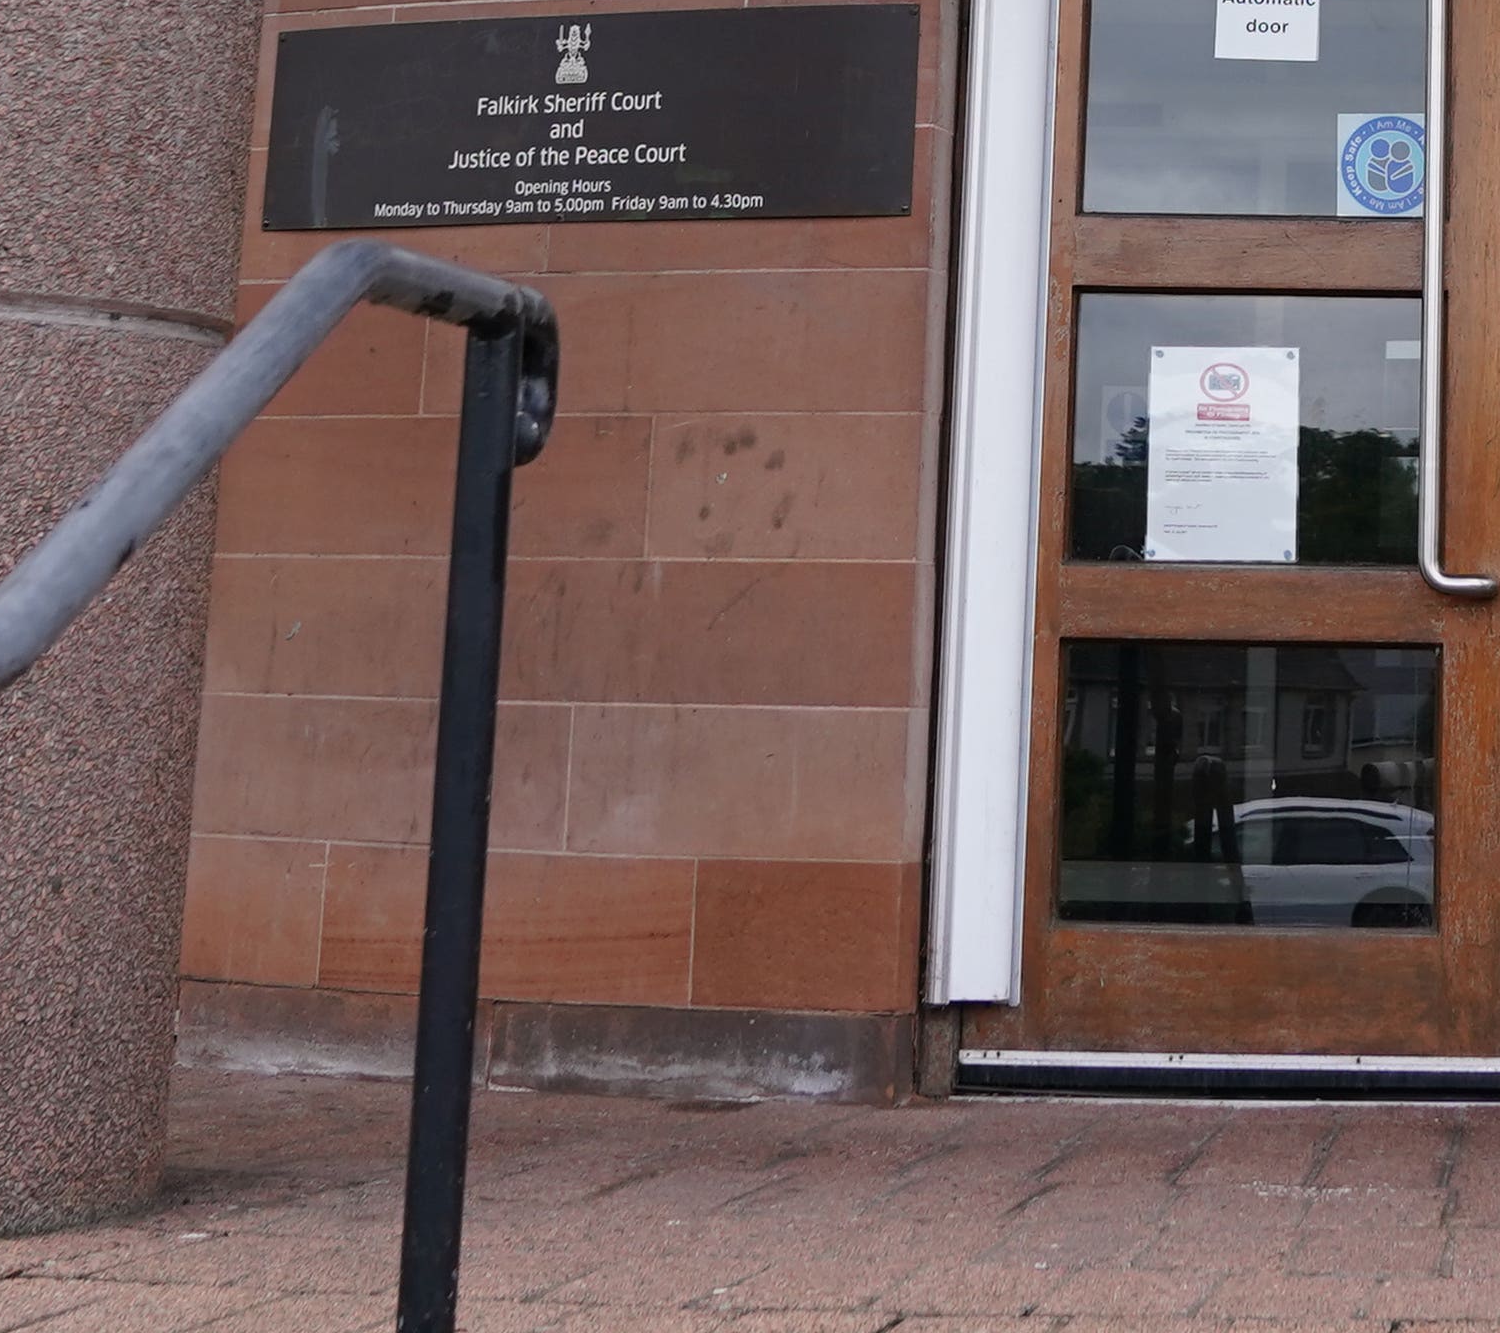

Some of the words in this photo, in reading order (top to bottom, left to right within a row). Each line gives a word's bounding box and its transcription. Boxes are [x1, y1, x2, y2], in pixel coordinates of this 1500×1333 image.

[1245, 16, 1289, 35] door
[477, 95, 539, 117] Falkirk
[544, 91, 606, 114] Sheriff
[611, 90, 662, 111] Court
[549, 119, 584, 139] and
[1377, 120, 1393, 130] Am
[448, 148, 511, 170] Justice
[515, 146, 536, 167] of
[540, 146, 569, 166] the
[575, 145, 629, 165] Peace
[634, 142, 687, 163] Court
[1344, 136, 1363, 162] Safe
[515, 180, 569, 196] Opening
[572, 179, 612, 193] Hours
[1346, 165, 1363, 197] Keep
[374, 203, 424, 218] Monday
[427, 202, 440, 215] to
[443, 200, 502, 216] Thursday
[506, 199, 533, 213] 9am
[537, 199, 551, 212] to
[554, 197, 604, 213] 5.00pm
[611, 195, 655, 212] Friday
[659, 195, 688, 210] 9am
[693, 195, 706, 209] to
[710, 193, 763, 210] 4.30pm
